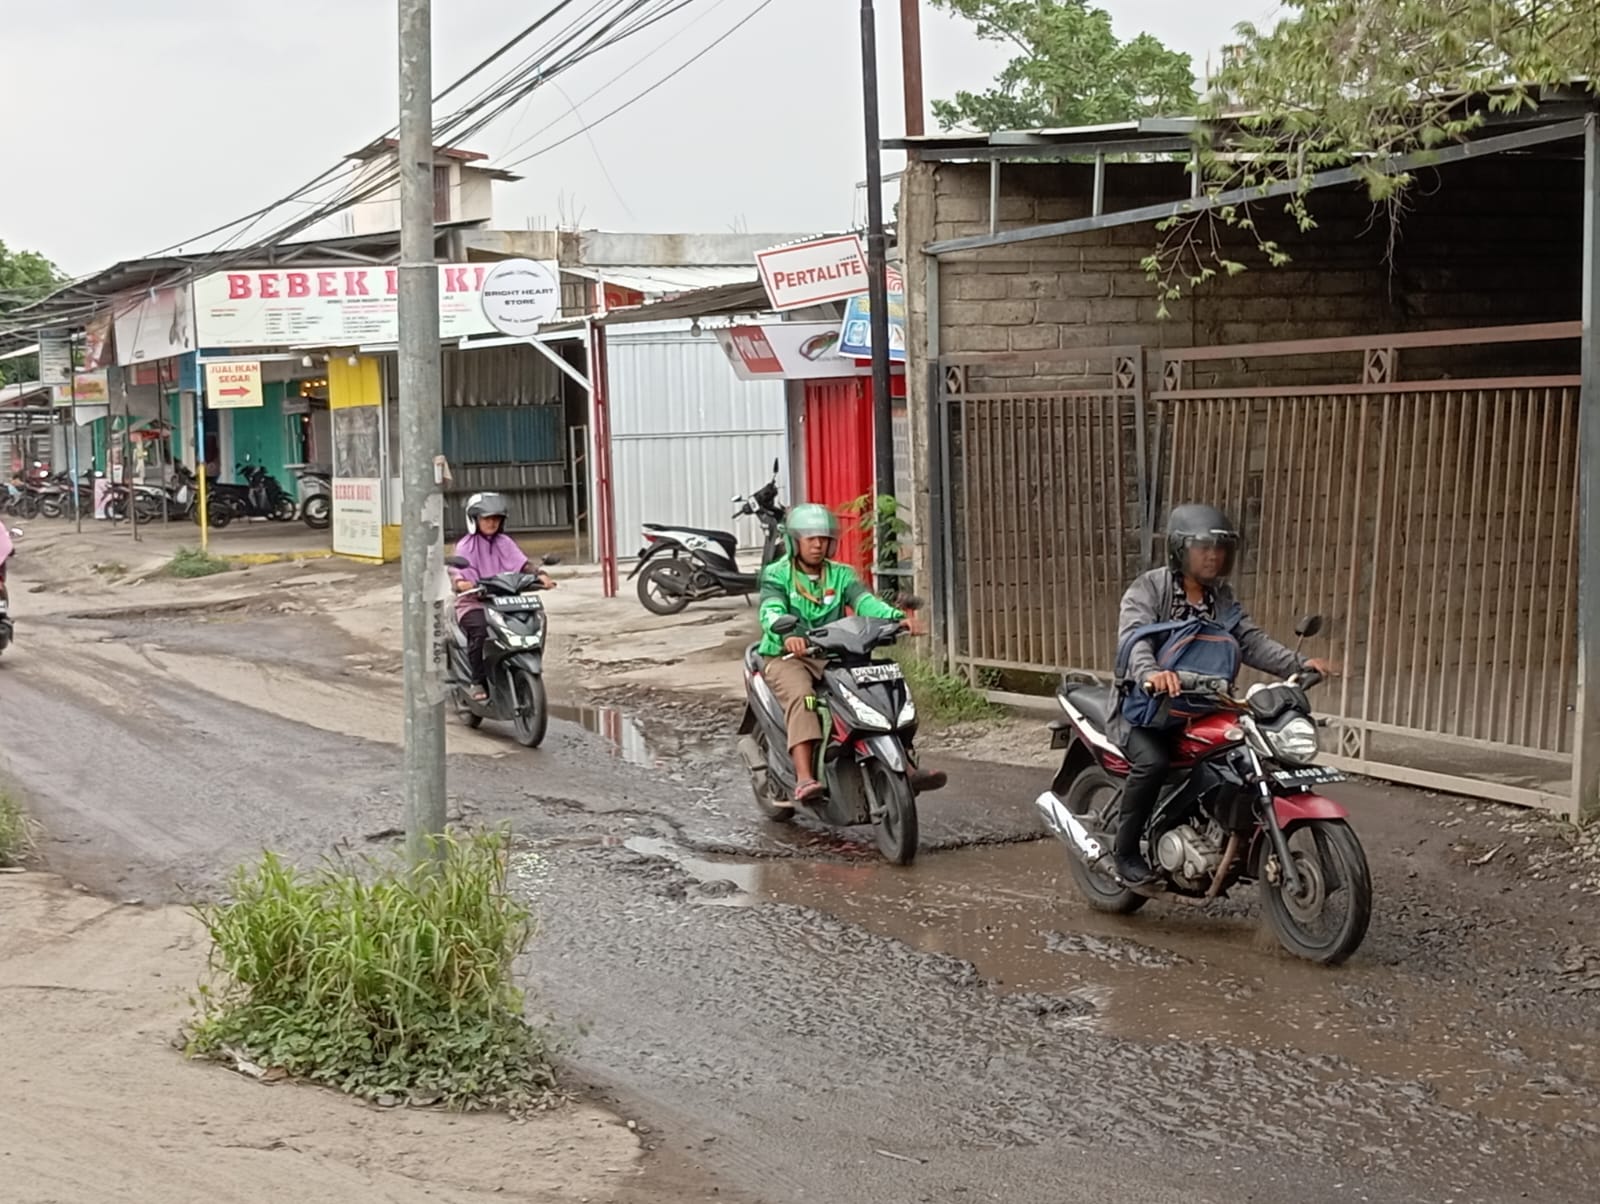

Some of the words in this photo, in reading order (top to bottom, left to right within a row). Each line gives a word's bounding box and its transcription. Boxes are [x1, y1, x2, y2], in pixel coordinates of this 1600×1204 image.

[227, 271, 369, 299] BEBEK
[773, 260, 862, 290] PERTALITE
[521, 288, 554, 296] HEART
